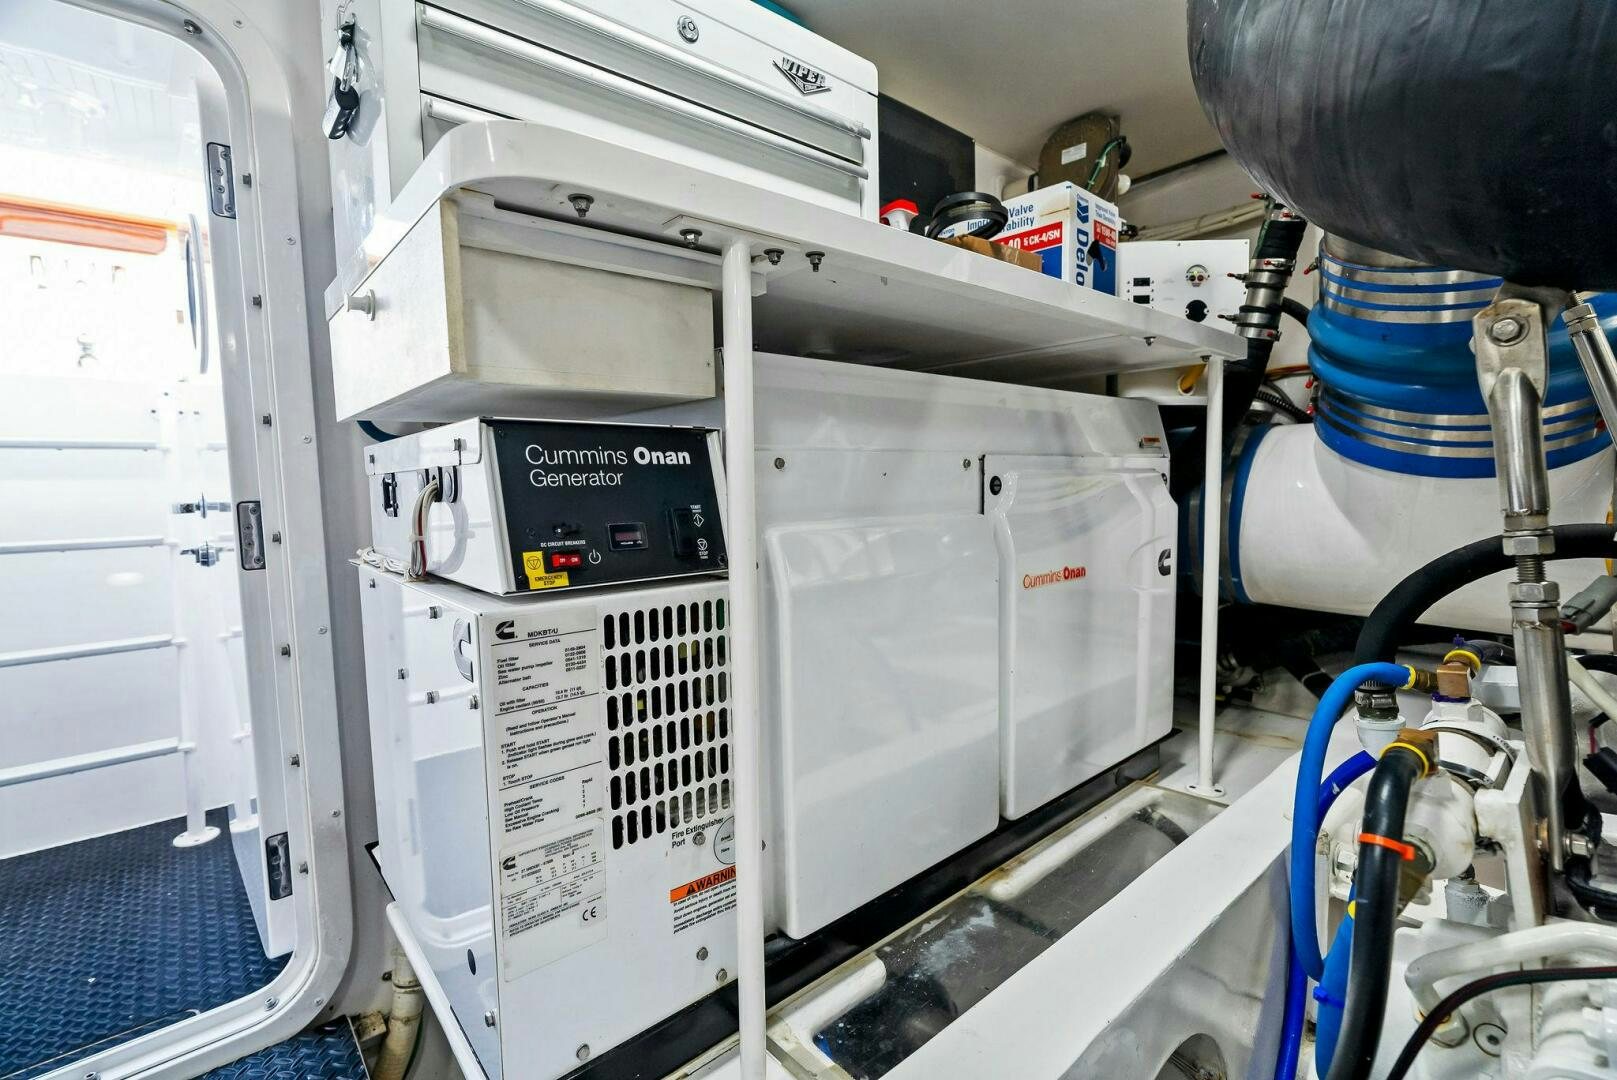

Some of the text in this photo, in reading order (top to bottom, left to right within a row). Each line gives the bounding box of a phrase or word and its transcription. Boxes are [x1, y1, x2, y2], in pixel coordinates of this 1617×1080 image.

[782, 57, 826, 86] VIPER
[1009, 204, 1034, 218] Valve
[1076, 227, 1089, 287] Delo
[525, 444, 691, 465] Cummins Onan
[529, 468, 624, 487] Generator
[1023, 566, 1086, 588] Cummins Onan
[528, 640, 548, 648] SERVICE
[522, 682, 548, 691] CAPACITIES
[532, 706, 557, 715] OPERATION
[501, 741, 516, 749] START
[529, 776, 564, 789] SERVICE CODES
[671, 817, 724, 840] Fire Extinguisher
[672, 838, 685, 848] Port
[696, 868, 736, 891] WARNIN
[582, 906, 596, 921] CE
